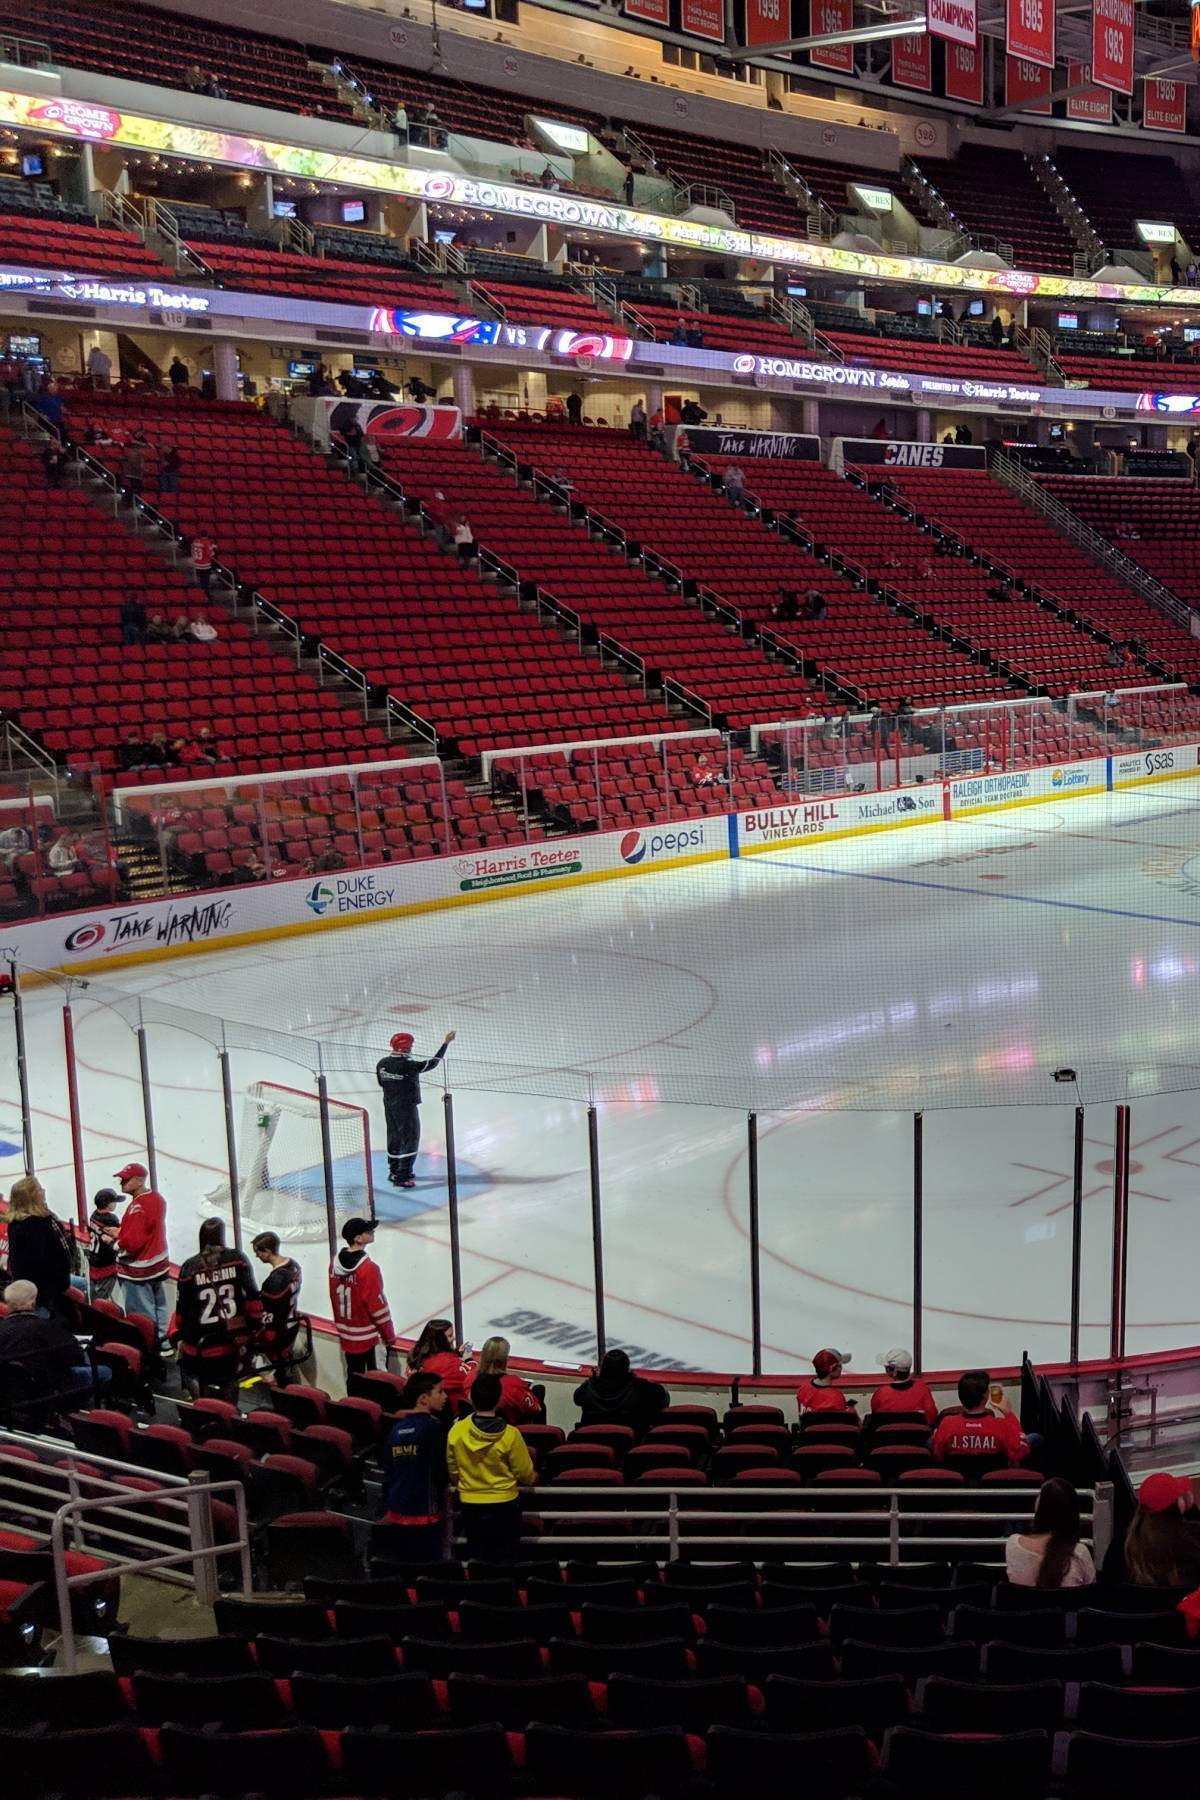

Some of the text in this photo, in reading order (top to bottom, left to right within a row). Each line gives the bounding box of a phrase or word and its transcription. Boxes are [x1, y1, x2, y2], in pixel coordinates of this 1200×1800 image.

[930, 0, 974, 33] CHAMPIONS
[1019, 0, 1043, 33] 1985
[1096, 0, 1132, 28] CHAMPIONS
[1103, 26, 1125, 65] 1983
[954, 46, 975, 73] 1980
[1017, 61, 1041, 84] 1982
[1155, 81, 1177, 101] 1986
[63, 103, 110, 122] HOME
[1071, 99, 1109, 115] ELITE EIGHT
[1147, 110, 1183, 124] ELITE EIGHT
[63, 114, 115, 133] GROWN
[461, 182, 620, 230] HOMEGROWN
[83, 282, 209, 311] Harris Teeter
[506, 326, 526, 346] VS
[758, 357, 877, 387] HOMEGROWN
[921, 379, 949, 391] PRESENTED
[950, 382, 960, 392] BY
[975, 384, 1008, 400] Harris
[1008, 387, 1041, 402] Teeter
[749, 434, 799, 460] WARNING
[883, 444, 944, 468] CANES
[953, 772, 1030, 799] RALEIGH ORTHOPAEDIC
[1063, 773, 1089, 786] Lottery
[858, 797, 936, 820] Michael Son
[960, 790, 1023, 807] OFFICIAL TEAM DOCTORS
[744, 802, 839, 832] BULLY HILL
[651, 825, 704, 852] pepsi
[762, 821, 825, 841] VINEYARDS
[475, 849, 580, 876] Harris Teeter
[336, 875, 375, 894] DUKE
[472, 873, 517, 888] Neighborhood
[517, 870, 532, 880] Food
[338, 888, 395, 912] ENERGY
[109, 899, 240, 946] TAKE WARNING
[199, 1283, 238, 1325] 23
[336, 1283, 352, 1321] 11
[262, 1311, 274, 1324] 23
[951, 1435, 997, 1449] J. STAAL
